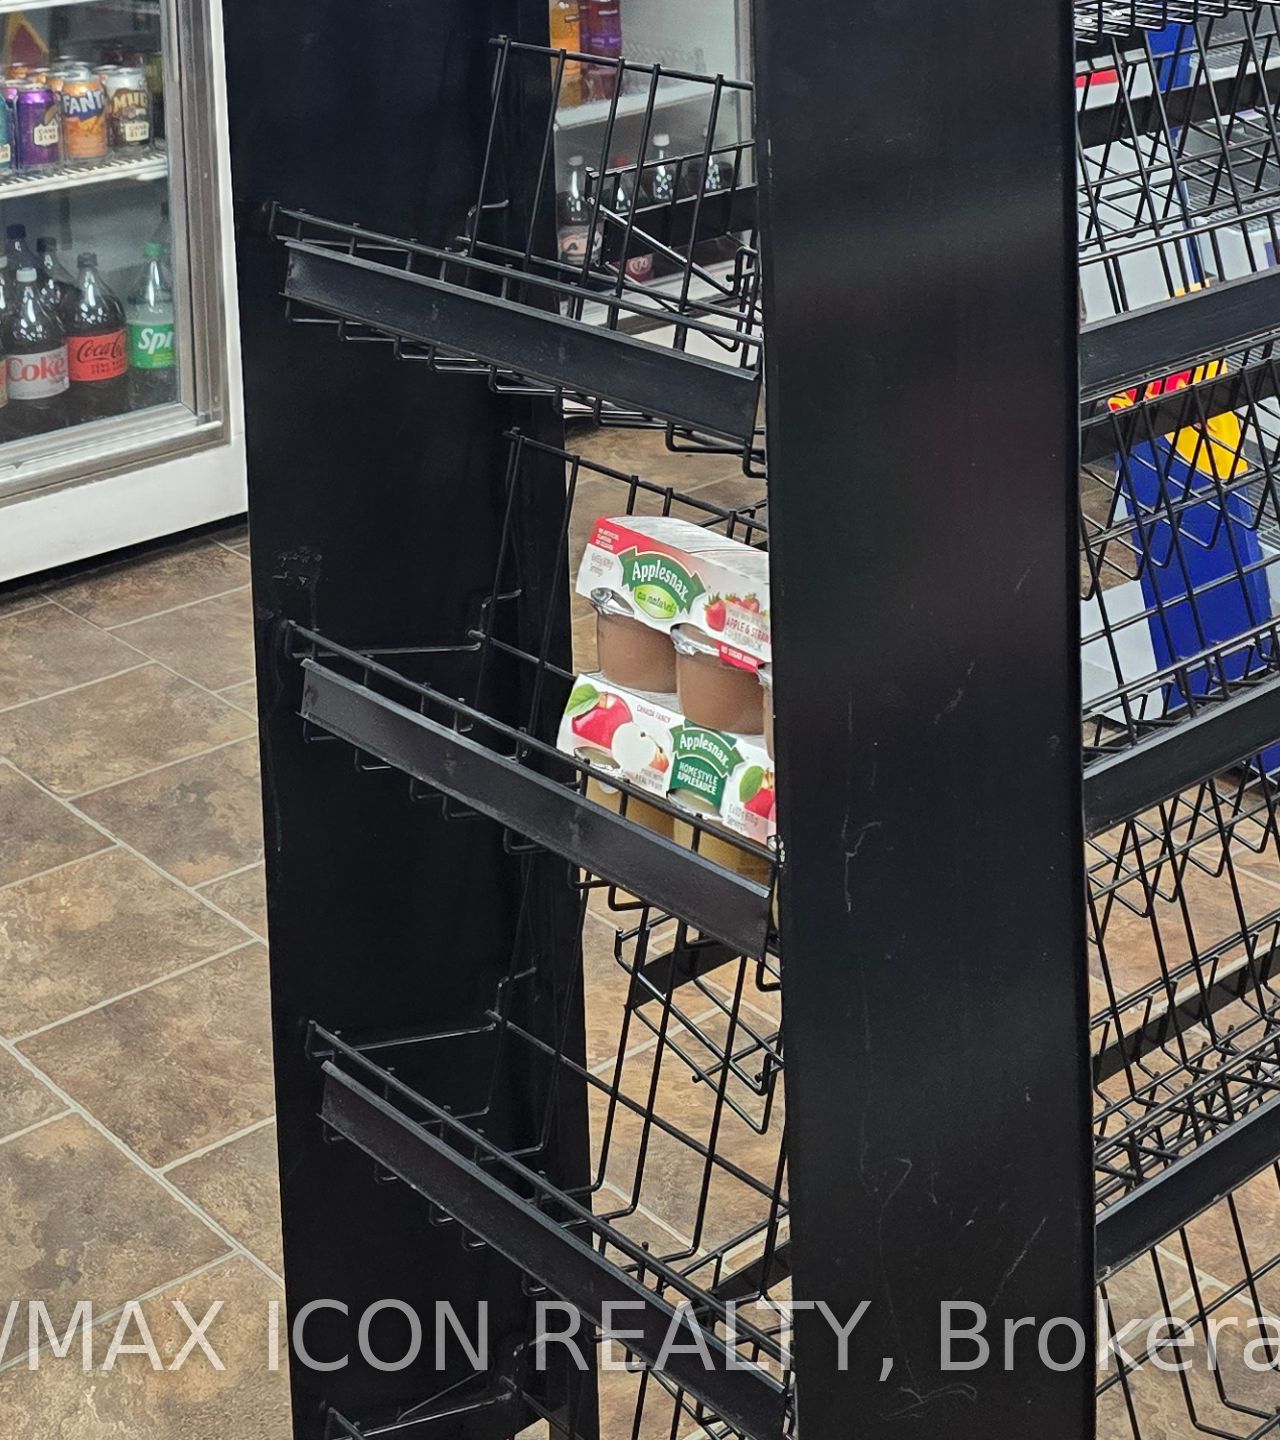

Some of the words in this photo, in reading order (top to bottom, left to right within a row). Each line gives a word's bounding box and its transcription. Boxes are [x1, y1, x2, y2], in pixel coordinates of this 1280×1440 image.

[632, 560, 689, 603] Applesnax
[726, 617, 746, 633] APPLE
[679, 734, 730, 768] Applesnax
[676, 771, 717, 796] APPLESAUCE
[679, 761, 719, 786] HOMESTYLE
